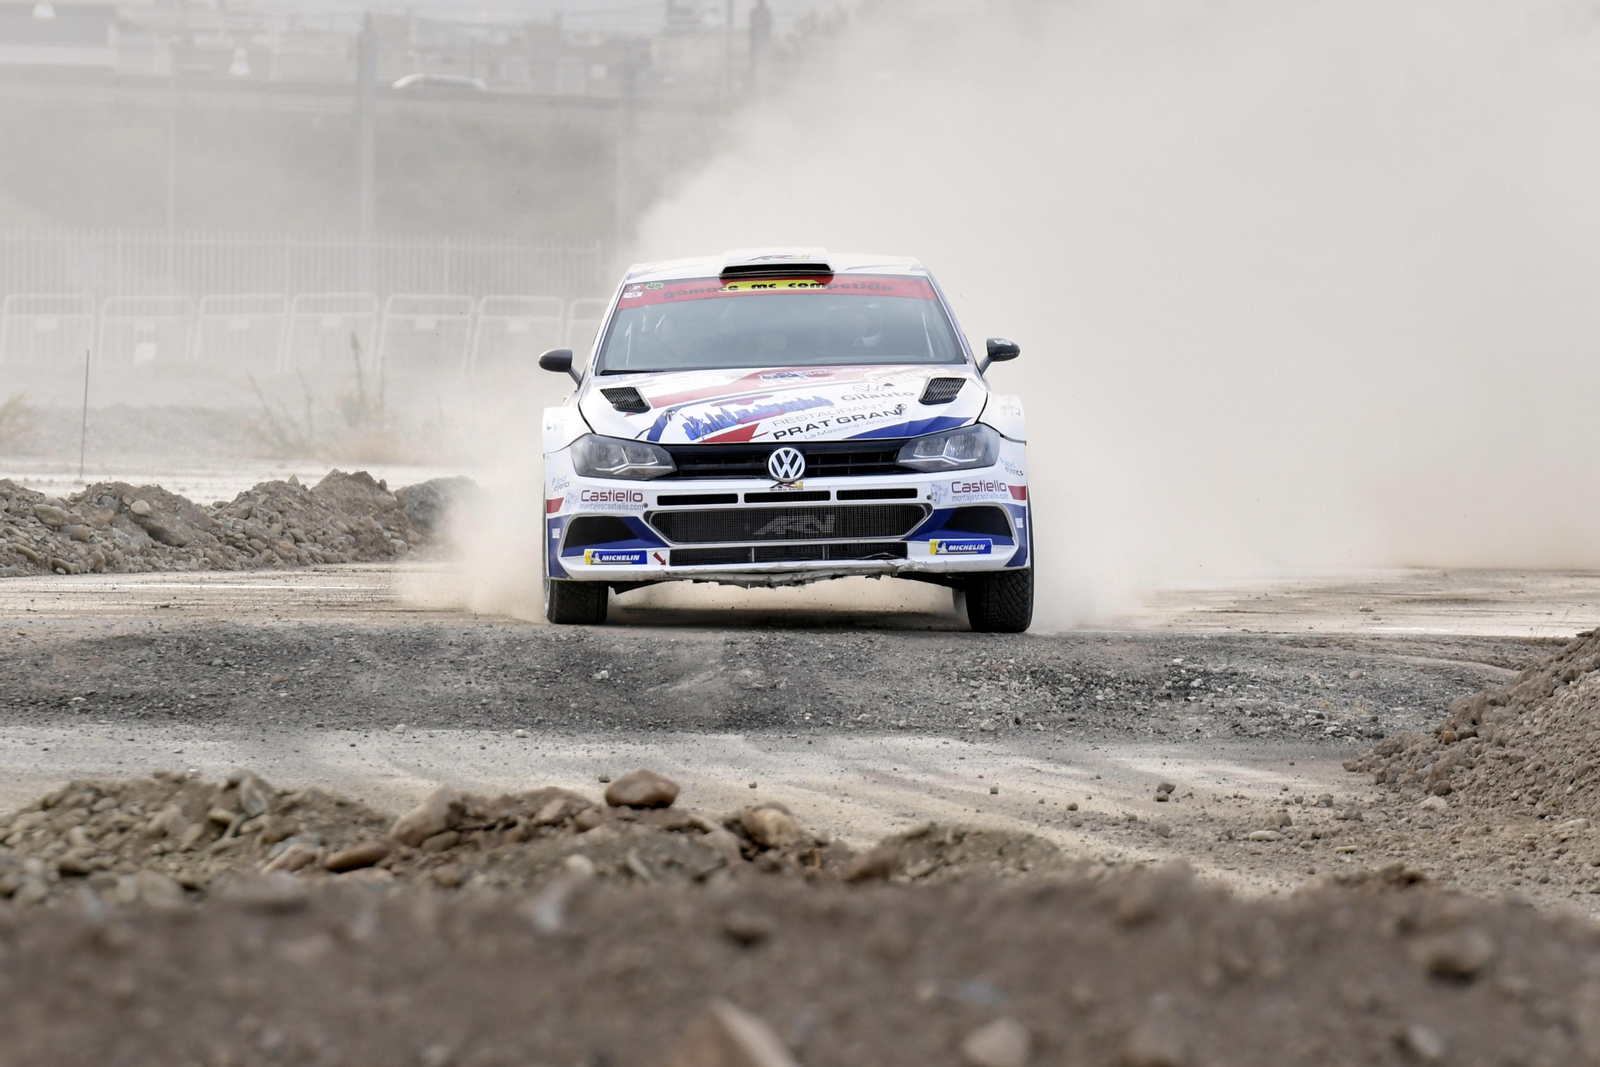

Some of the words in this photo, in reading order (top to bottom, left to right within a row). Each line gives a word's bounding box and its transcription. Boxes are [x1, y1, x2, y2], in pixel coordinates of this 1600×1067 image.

[840, 391, 914, 401] Gilauto
[773, 402, 884, 427] RESTAURANT
[773, 419, 833, 440] PRAT
[817, 422, 861, 438] Massana
[951, 480, 1008, 493] Castiello
[581, 490, 644, 502] Castiello
[948, 543, 986, 551] MICHELIN
